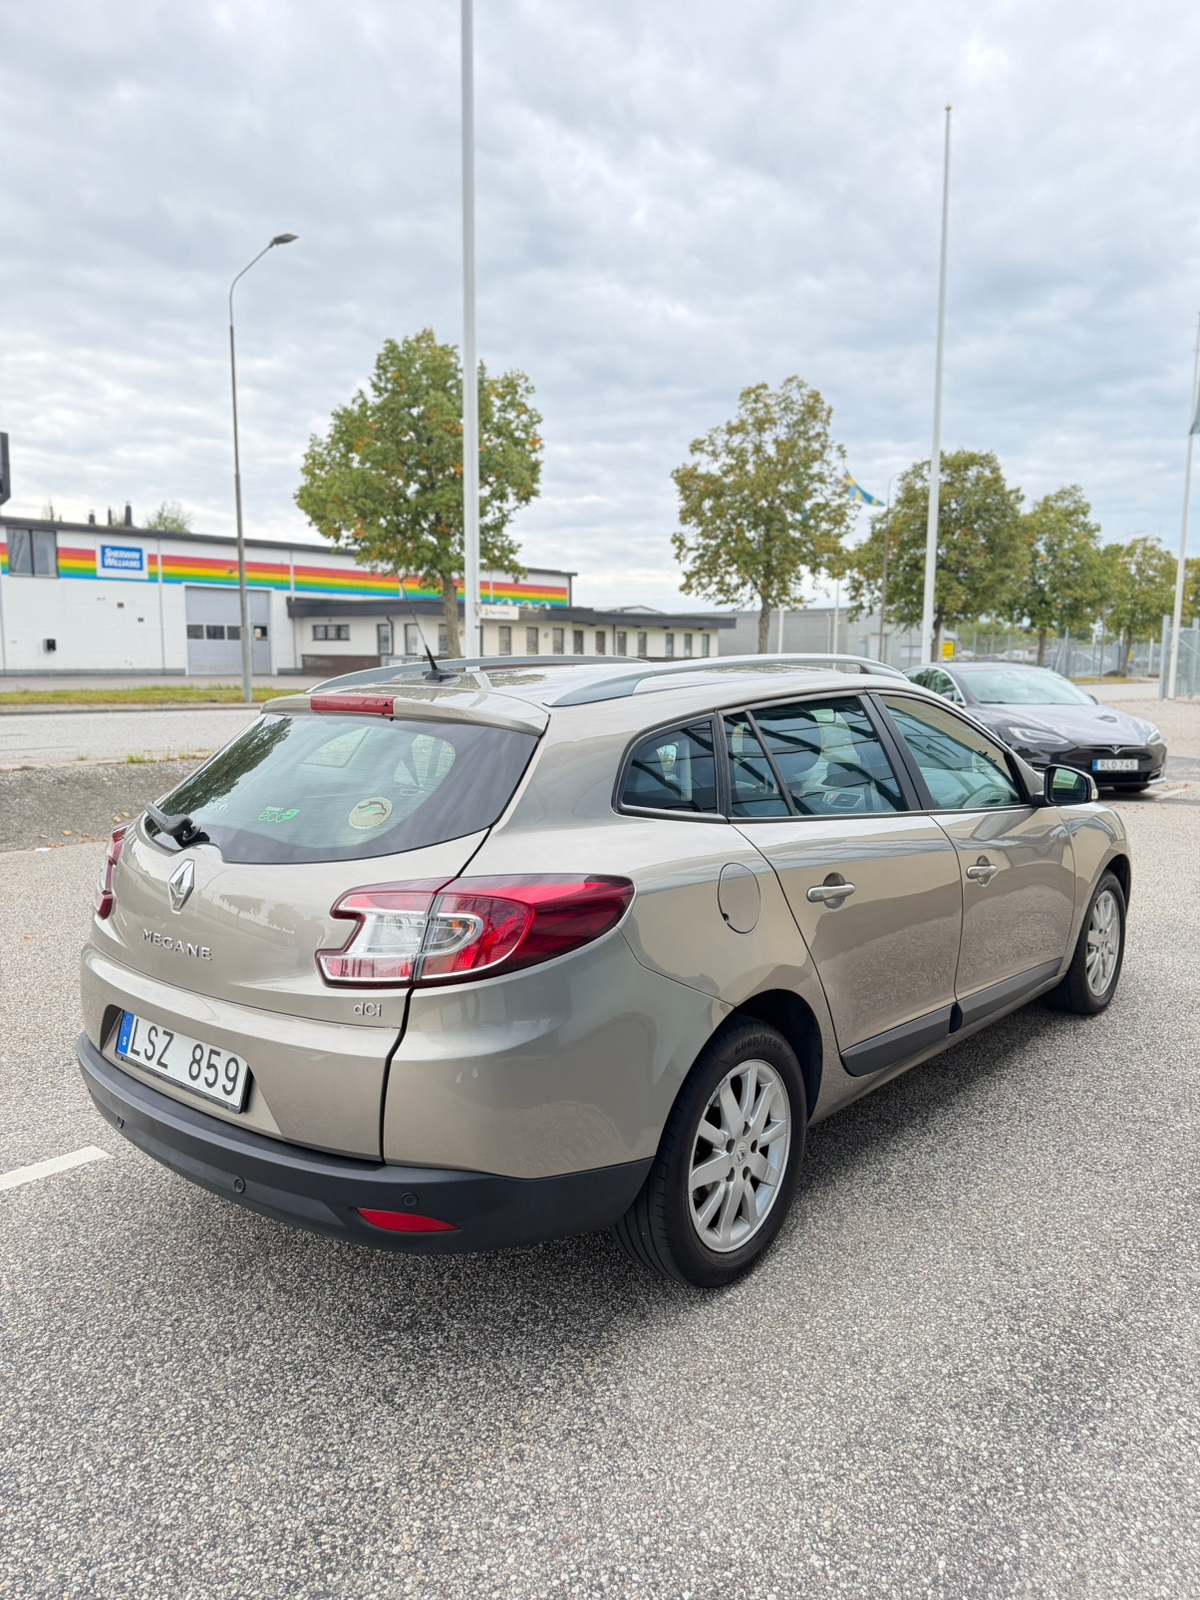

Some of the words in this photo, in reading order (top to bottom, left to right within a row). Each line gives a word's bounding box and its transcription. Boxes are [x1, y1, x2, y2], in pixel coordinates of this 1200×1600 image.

[104, 548, 141, 559] SHERWIN
[104, 556, 141, 568] WILLIAMS
[1100, 760, 1117, 770] RLD
[1120, 760, 1135, 769] 745
[143, 928, 213, 961] MEGANE
[353, 1001, 382, 1017] dCi
[121, 1036, 128, 1047] S
[735, 1034, 784, 1055] GOODYEAR
[130, 1018, 175, 1070] LSZ
[188, 1043, 240, 1096] 859
